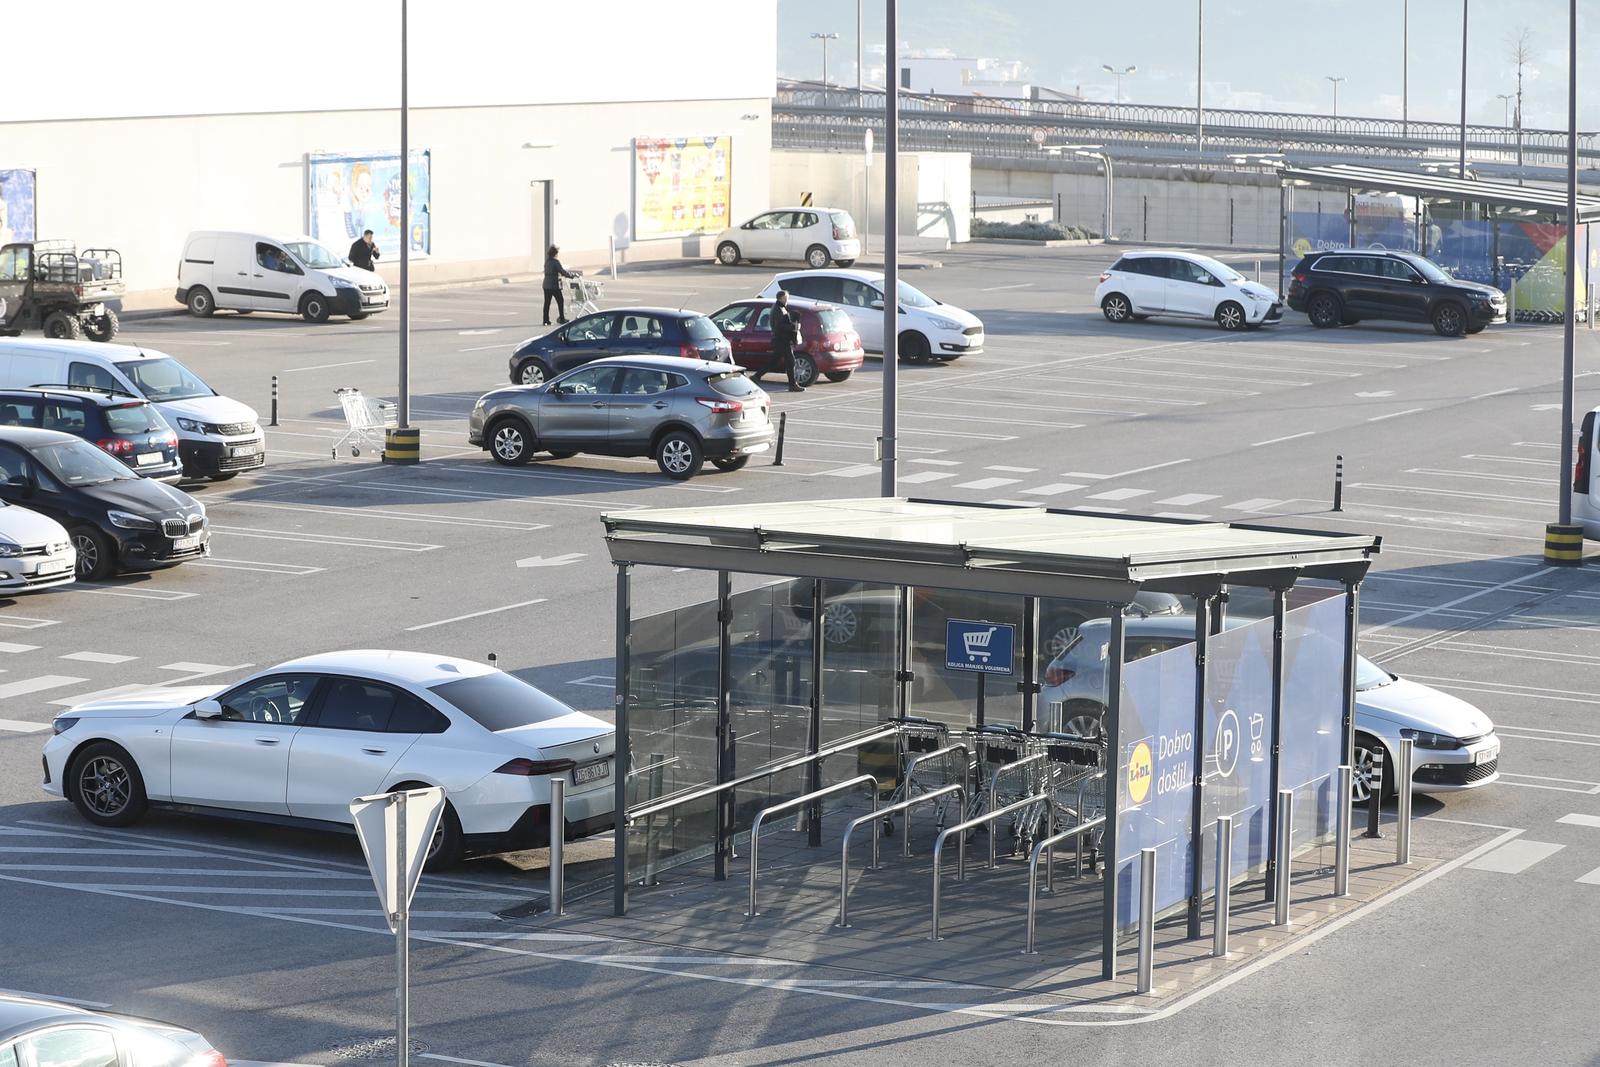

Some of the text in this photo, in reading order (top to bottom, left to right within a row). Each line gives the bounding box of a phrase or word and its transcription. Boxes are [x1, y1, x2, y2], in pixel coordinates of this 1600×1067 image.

[1317, 239, 1345, 249] Dobro
[1159, 730, 1192, 760] Dobro
[1223, 729, 1233, 760] P
[1157, 760, 1187, 795] došli!
